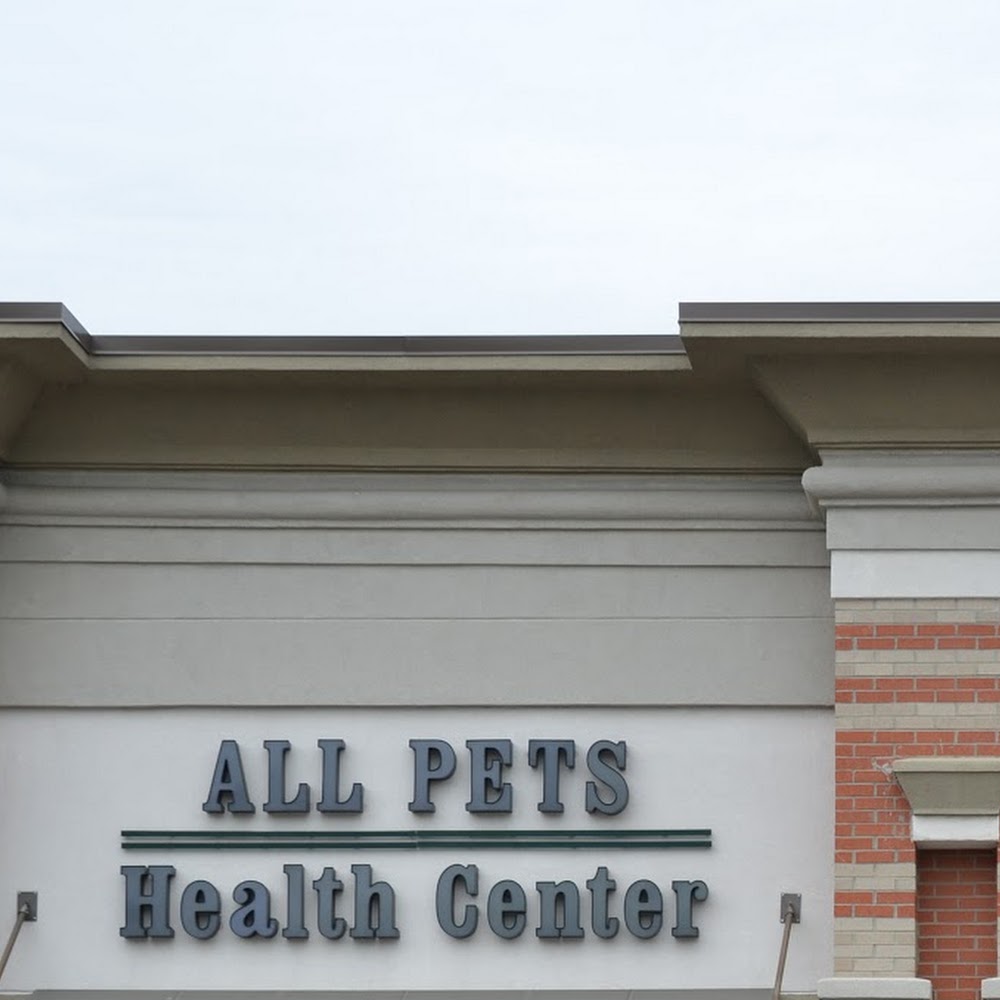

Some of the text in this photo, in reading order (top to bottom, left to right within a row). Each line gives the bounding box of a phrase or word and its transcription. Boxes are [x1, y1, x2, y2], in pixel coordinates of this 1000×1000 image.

[203, 739, 629, 816] ALL PETS
[120, 864, 709, 940] Health Center
